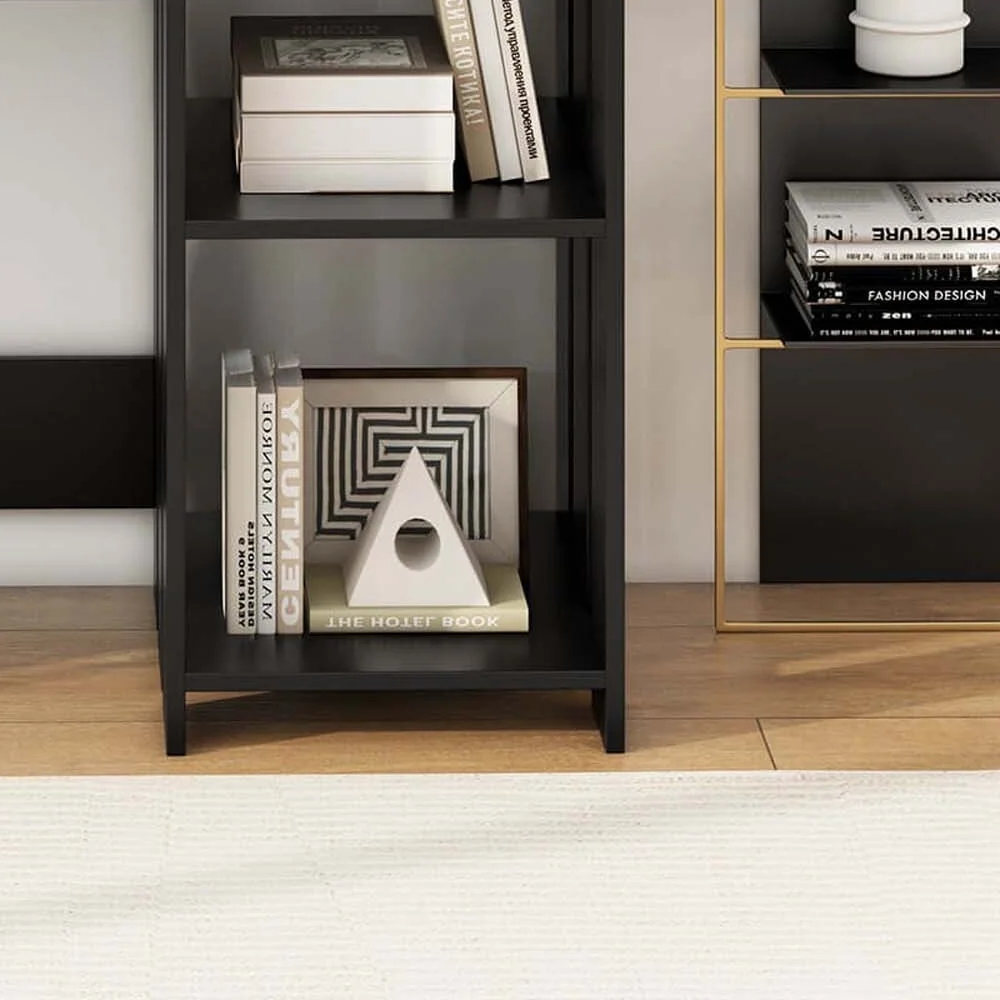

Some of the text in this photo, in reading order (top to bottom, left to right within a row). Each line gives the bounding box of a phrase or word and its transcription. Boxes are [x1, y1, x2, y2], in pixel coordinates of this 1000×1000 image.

[453, 46, 486, 125] КОТИКА!
[518, 99, 538, 160] проектами
[868, 290, 929, 301] FASHION
[934, 290, 986, 301] DESIGN
